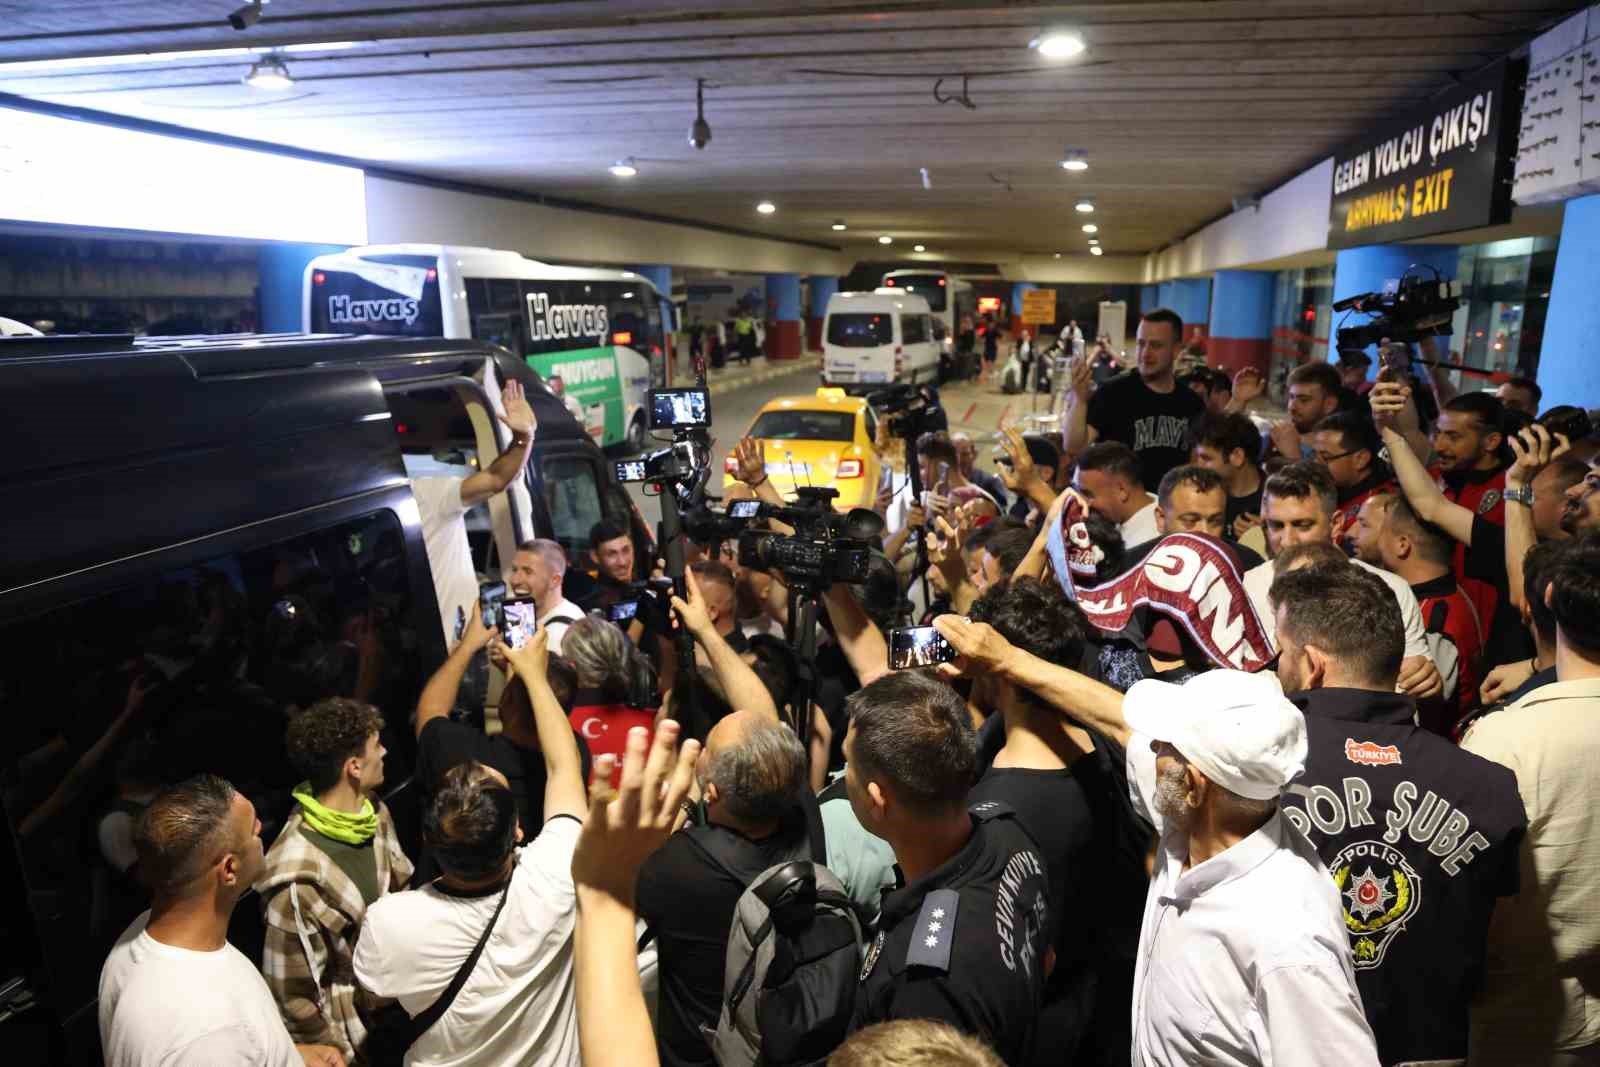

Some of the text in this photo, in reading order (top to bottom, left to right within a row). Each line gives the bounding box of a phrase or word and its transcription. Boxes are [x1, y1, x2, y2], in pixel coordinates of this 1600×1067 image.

[1334, 90, 1493, 195] GELEN YOLCU ÇIKIŞI
[1345, 168, 1454, 232] ARRIVALS EXIT
[328, 294, 419, 326] Havaş
[526, 292, 609, 347] Havaş
[1283, 777, 1491, 878] POR ŞUBE
